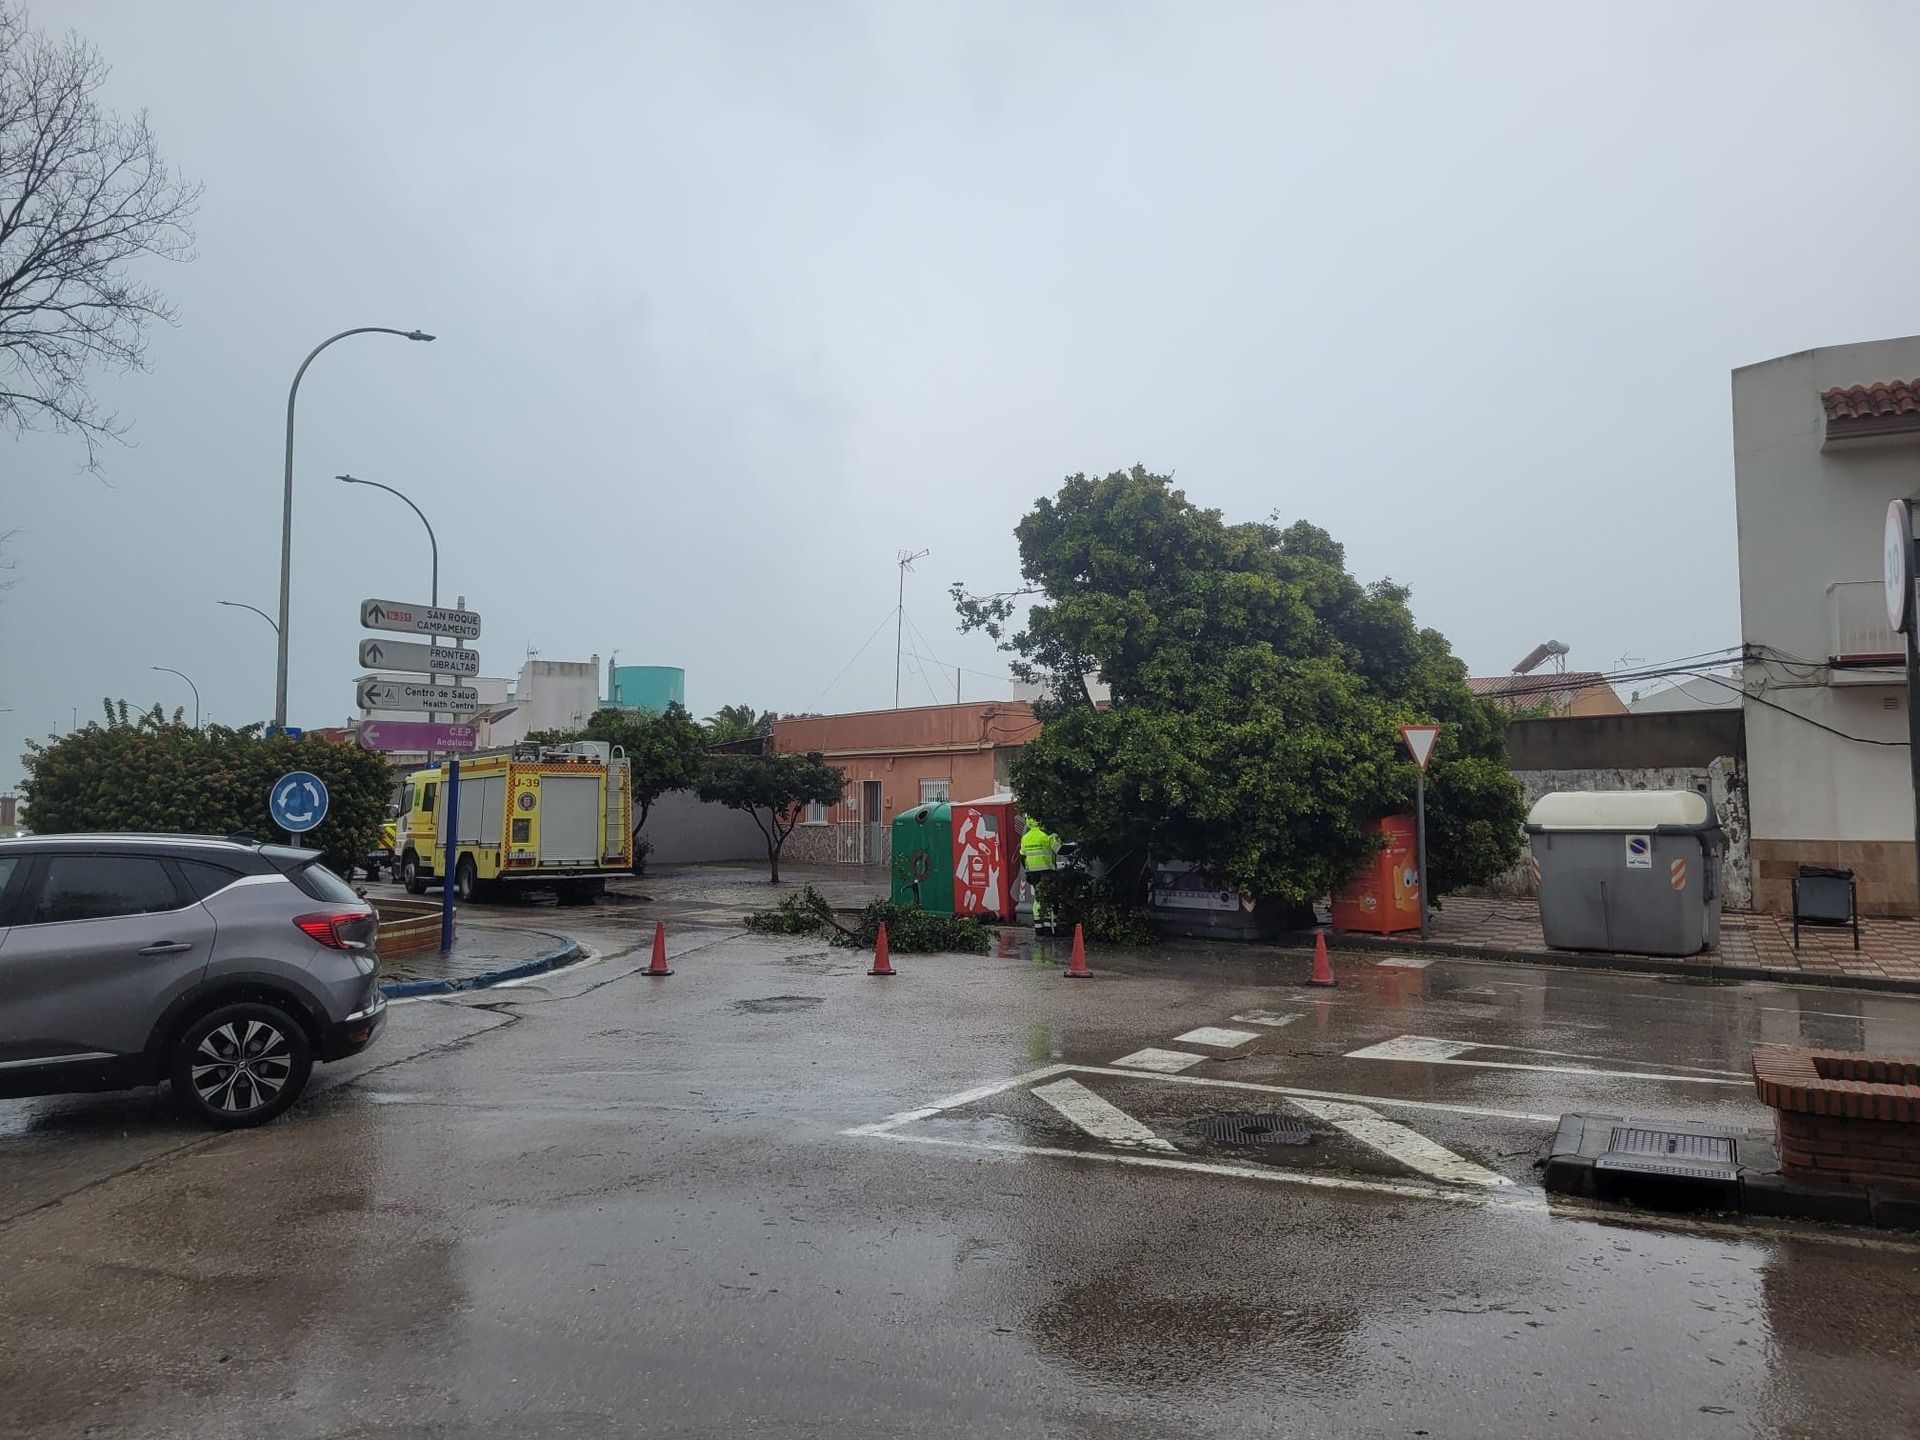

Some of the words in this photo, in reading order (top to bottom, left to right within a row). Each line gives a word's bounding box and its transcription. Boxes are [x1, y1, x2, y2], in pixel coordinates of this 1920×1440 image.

[427, 610, 445, 621] SAN
[448, 613, 478, 625] ROQUE
[417, 621, 478, 636] CAMPAMENTO
[430, 649, 476, 661] FRONTERA
[430, 660, 476, 672] GIBRALTAR
[405, 687, 435, 697] Centro
[438, 690, 448, 698] de
[451, 690, 475, 700] Salud
[422, 701, 448, 709] Health
[450, 702, 474, 710] Centre
[449, 727, 473, 737] C.E.P.
[514, 778, 540, 788] U-39
